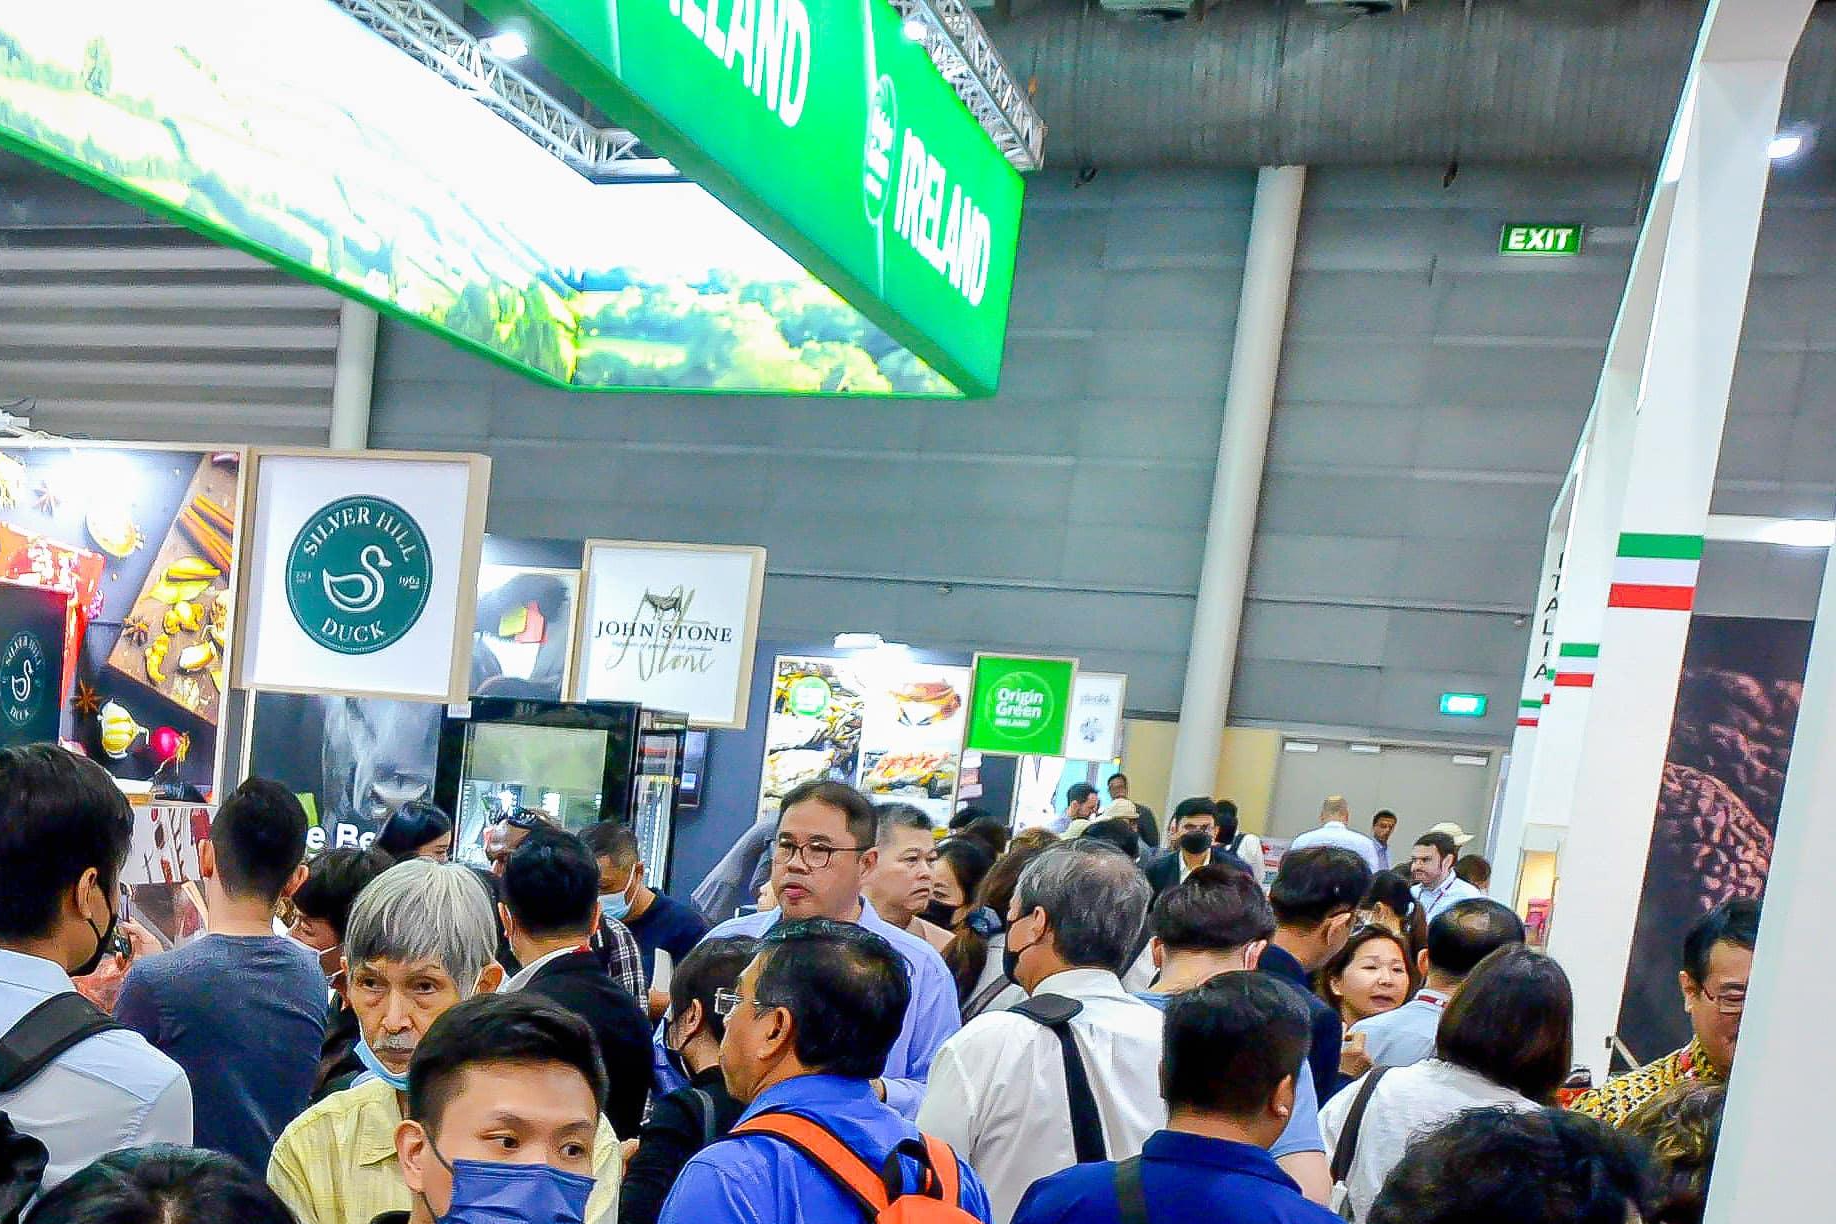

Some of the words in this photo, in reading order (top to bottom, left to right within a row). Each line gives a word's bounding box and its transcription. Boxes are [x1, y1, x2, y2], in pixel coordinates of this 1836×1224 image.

[894, 128, 992, 306] IRELAND
[1508, 228, 1573, 250] EXIT
[304, 506, 371, 557] SILVER
[375, 511, 417, 563] HILL
[321, 617, 385, 642] DUCK
[595, 621, 654, 639] JOHN
[662, 623, 732, 643] STONE
[996, 687, 1044, 705] Origin
[995, 702, 1042, 719] Green
